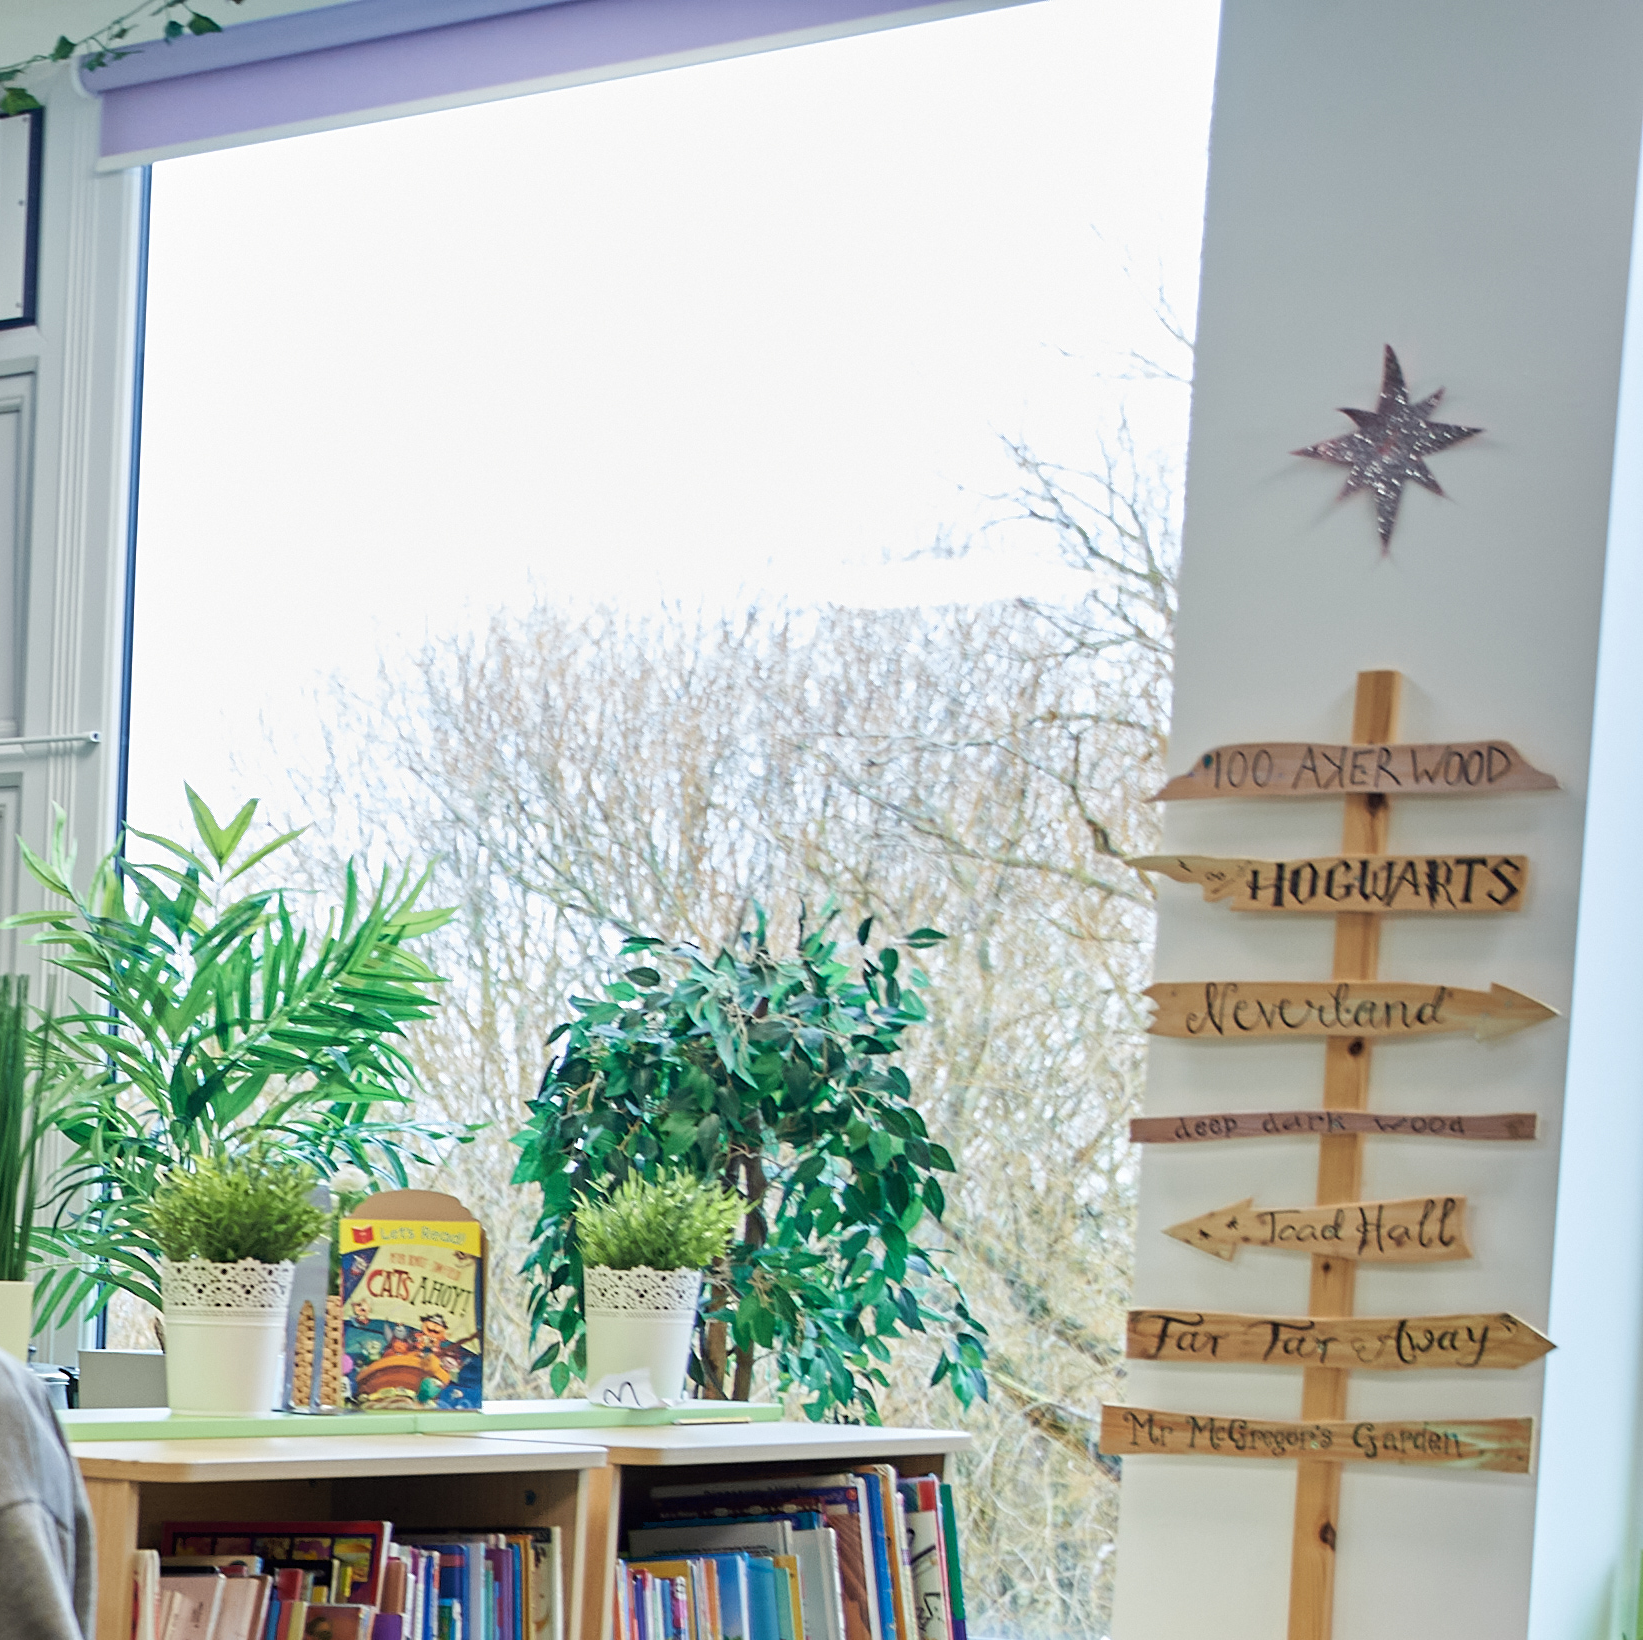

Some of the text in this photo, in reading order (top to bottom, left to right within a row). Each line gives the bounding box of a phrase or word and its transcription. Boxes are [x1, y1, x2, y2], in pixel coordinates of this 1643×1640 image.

[1210, 747, 1275, 791] 100
[1412, 742, 1512, 789] WOOD
[1247, 855, 1524, 909] HOGWARTS
[1187, 983, 1453, 1036] Neverland
[1174, 1115, 1238, 1141] deep
[1376, 1113, 1466, 1135] wood
[1262, 1196, 1457, 1252] Toad Hall
[366, 1268, 474, 1318] CATS AHOY!
[1352, 1316, 1491, 1367] Away
[1123, 1409, 1172, 1450] Mr
[1352, 1421, 1462, 1458] Garden
